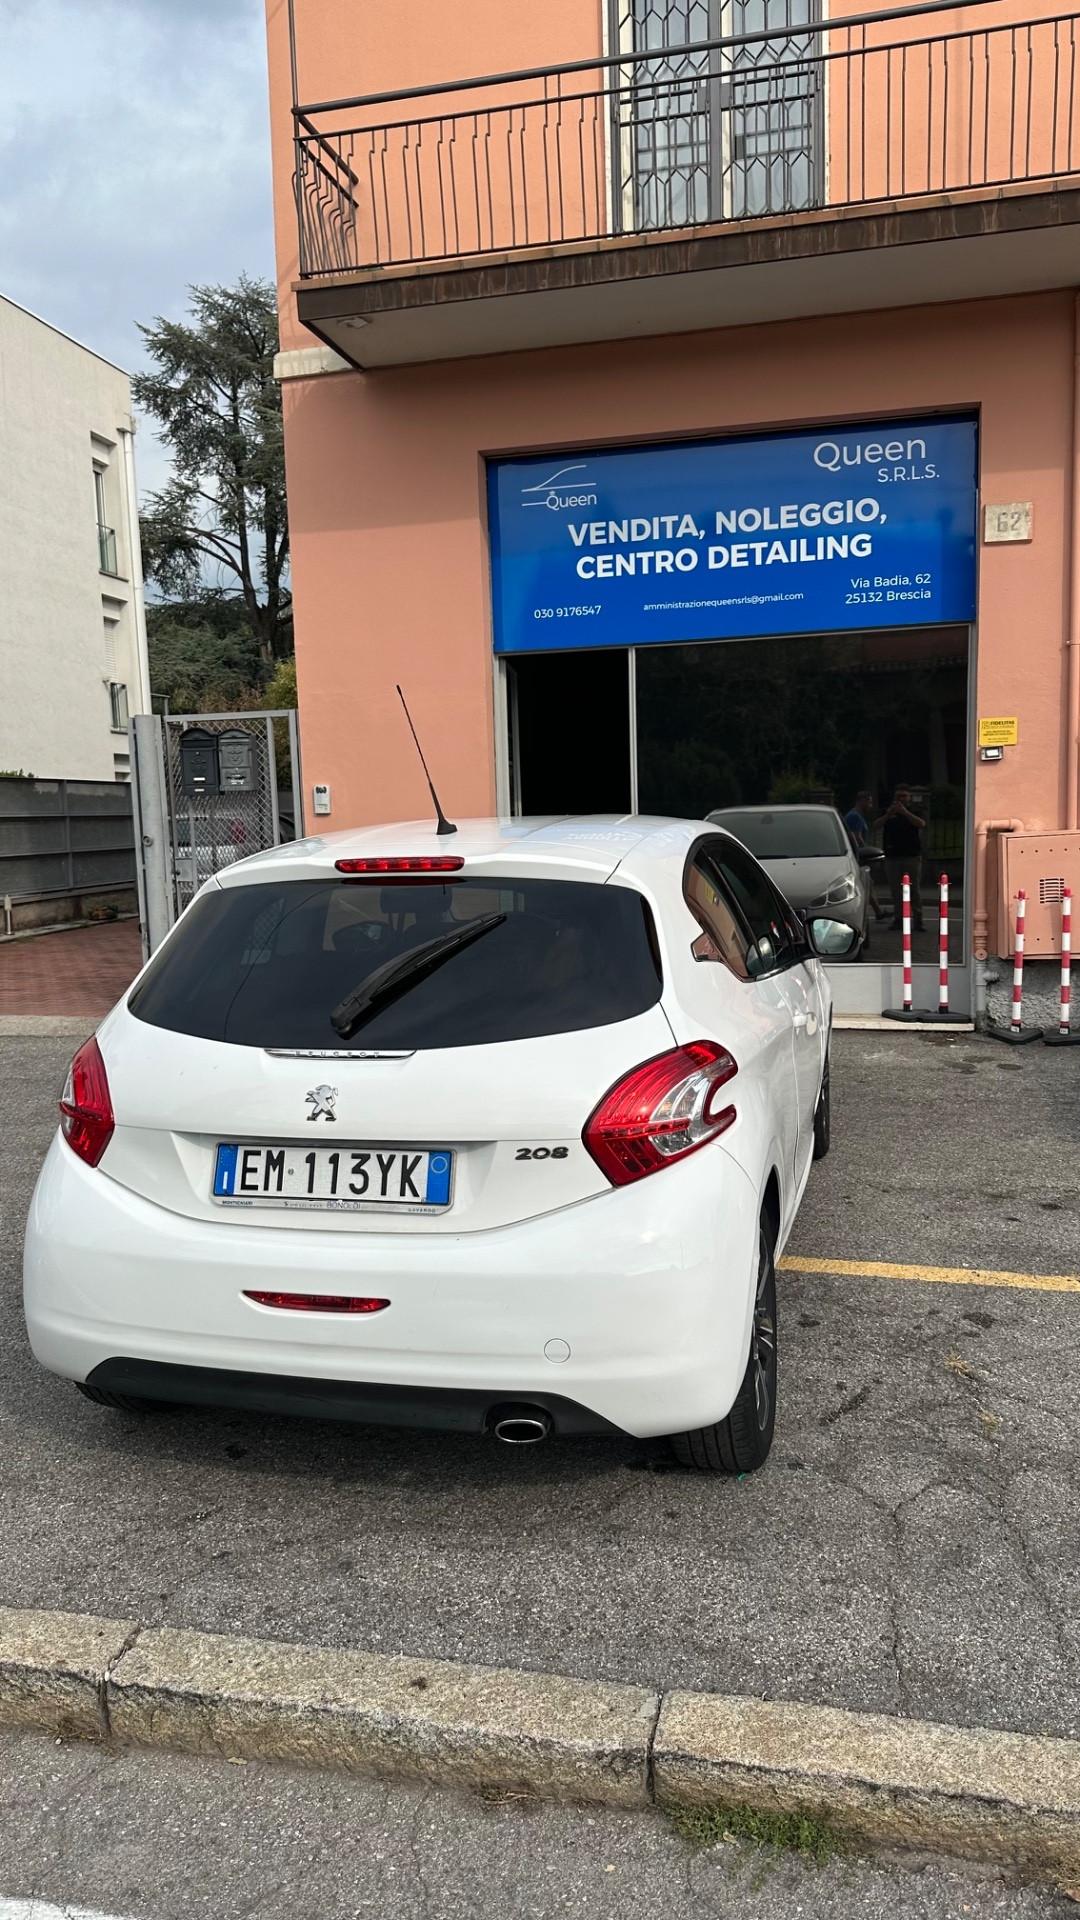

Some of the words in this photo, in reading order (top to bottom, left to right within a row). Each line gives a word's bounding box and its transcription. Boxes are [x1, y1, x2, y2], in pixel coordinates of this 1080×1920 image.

[813, 438, 926, 472] Queen
[877, 464, 941, 483] S.R.L.S.
[546, 493, 597, 511] Queen
[567, 514, 706, 547] VENDITA,
[715, 497, 887, 535] NOLEGGIO,
[997, 511, 1022, 532] 62
[576, 548, 699, 579] CENTRO
[708, 533, 872, 570] DETAILING
[850, 578, 870, 589] Via
[874, 575, 912, 587] Badia,
[915, 573, 931, 584] 62
[643, 592, 804, 611] amministrazionequeensrls@gmail.com
[845, 592, 883, 605] 25132
[886, 589, 931, 601] Brescia
[534, 608, 554, 619] 030
[556, 605, 602, 617] 9176547
[515, 1146, 569, 1160] 208
[240, 1149, 286, 1192] EM
[305, 1151, 423, 1198] 113YK
